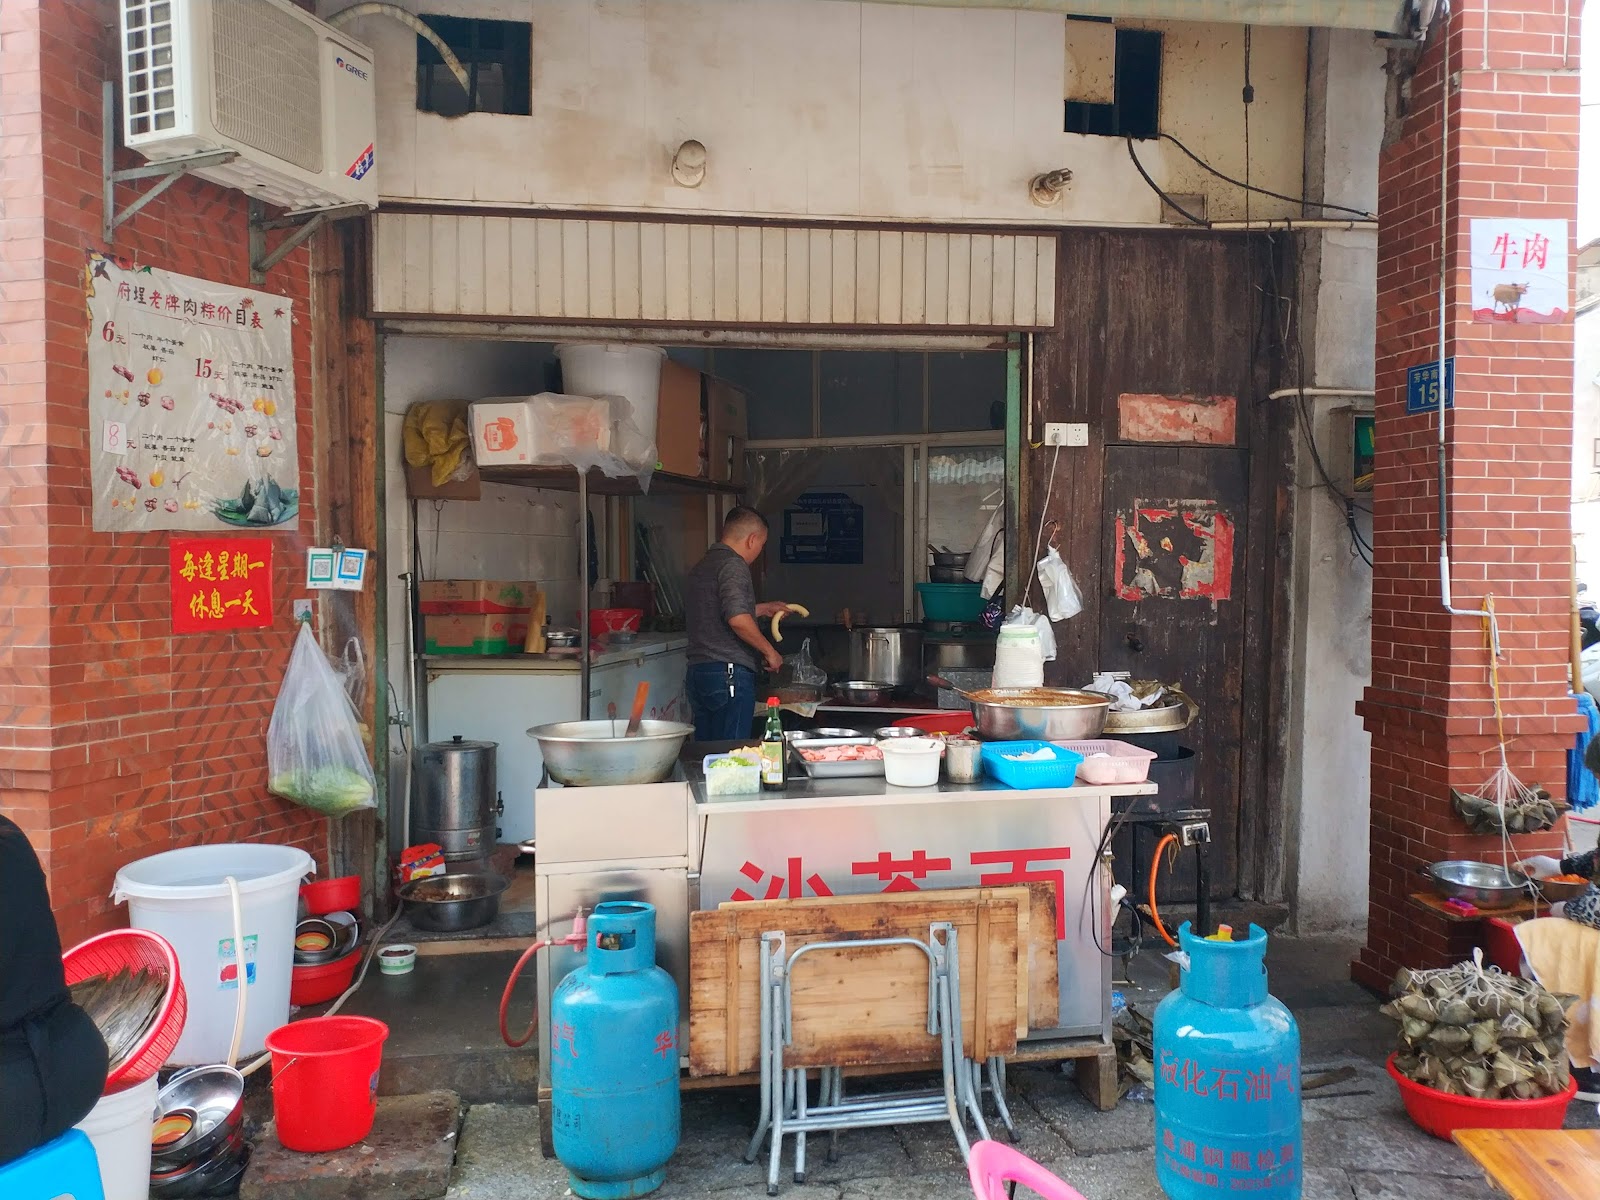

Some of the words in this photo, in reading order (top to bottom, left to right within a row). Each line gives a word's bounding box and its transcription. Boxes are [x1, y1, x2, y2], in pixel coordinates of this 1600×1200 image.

[345, 63, 368, 81] GREE
[1490, 232, 1550, 270] 牛肉
[117, 281, 264, 330] 府埕老牌肉粽价目表
[194, 357, 225, 380] 15元
[1413, 367, 1448, 384] 芳华南
[1418, 382, 1448, 405] 15
[179, 550, 265, 582] 每逢星期一
[189, 588, 260, 620] 休息一天
